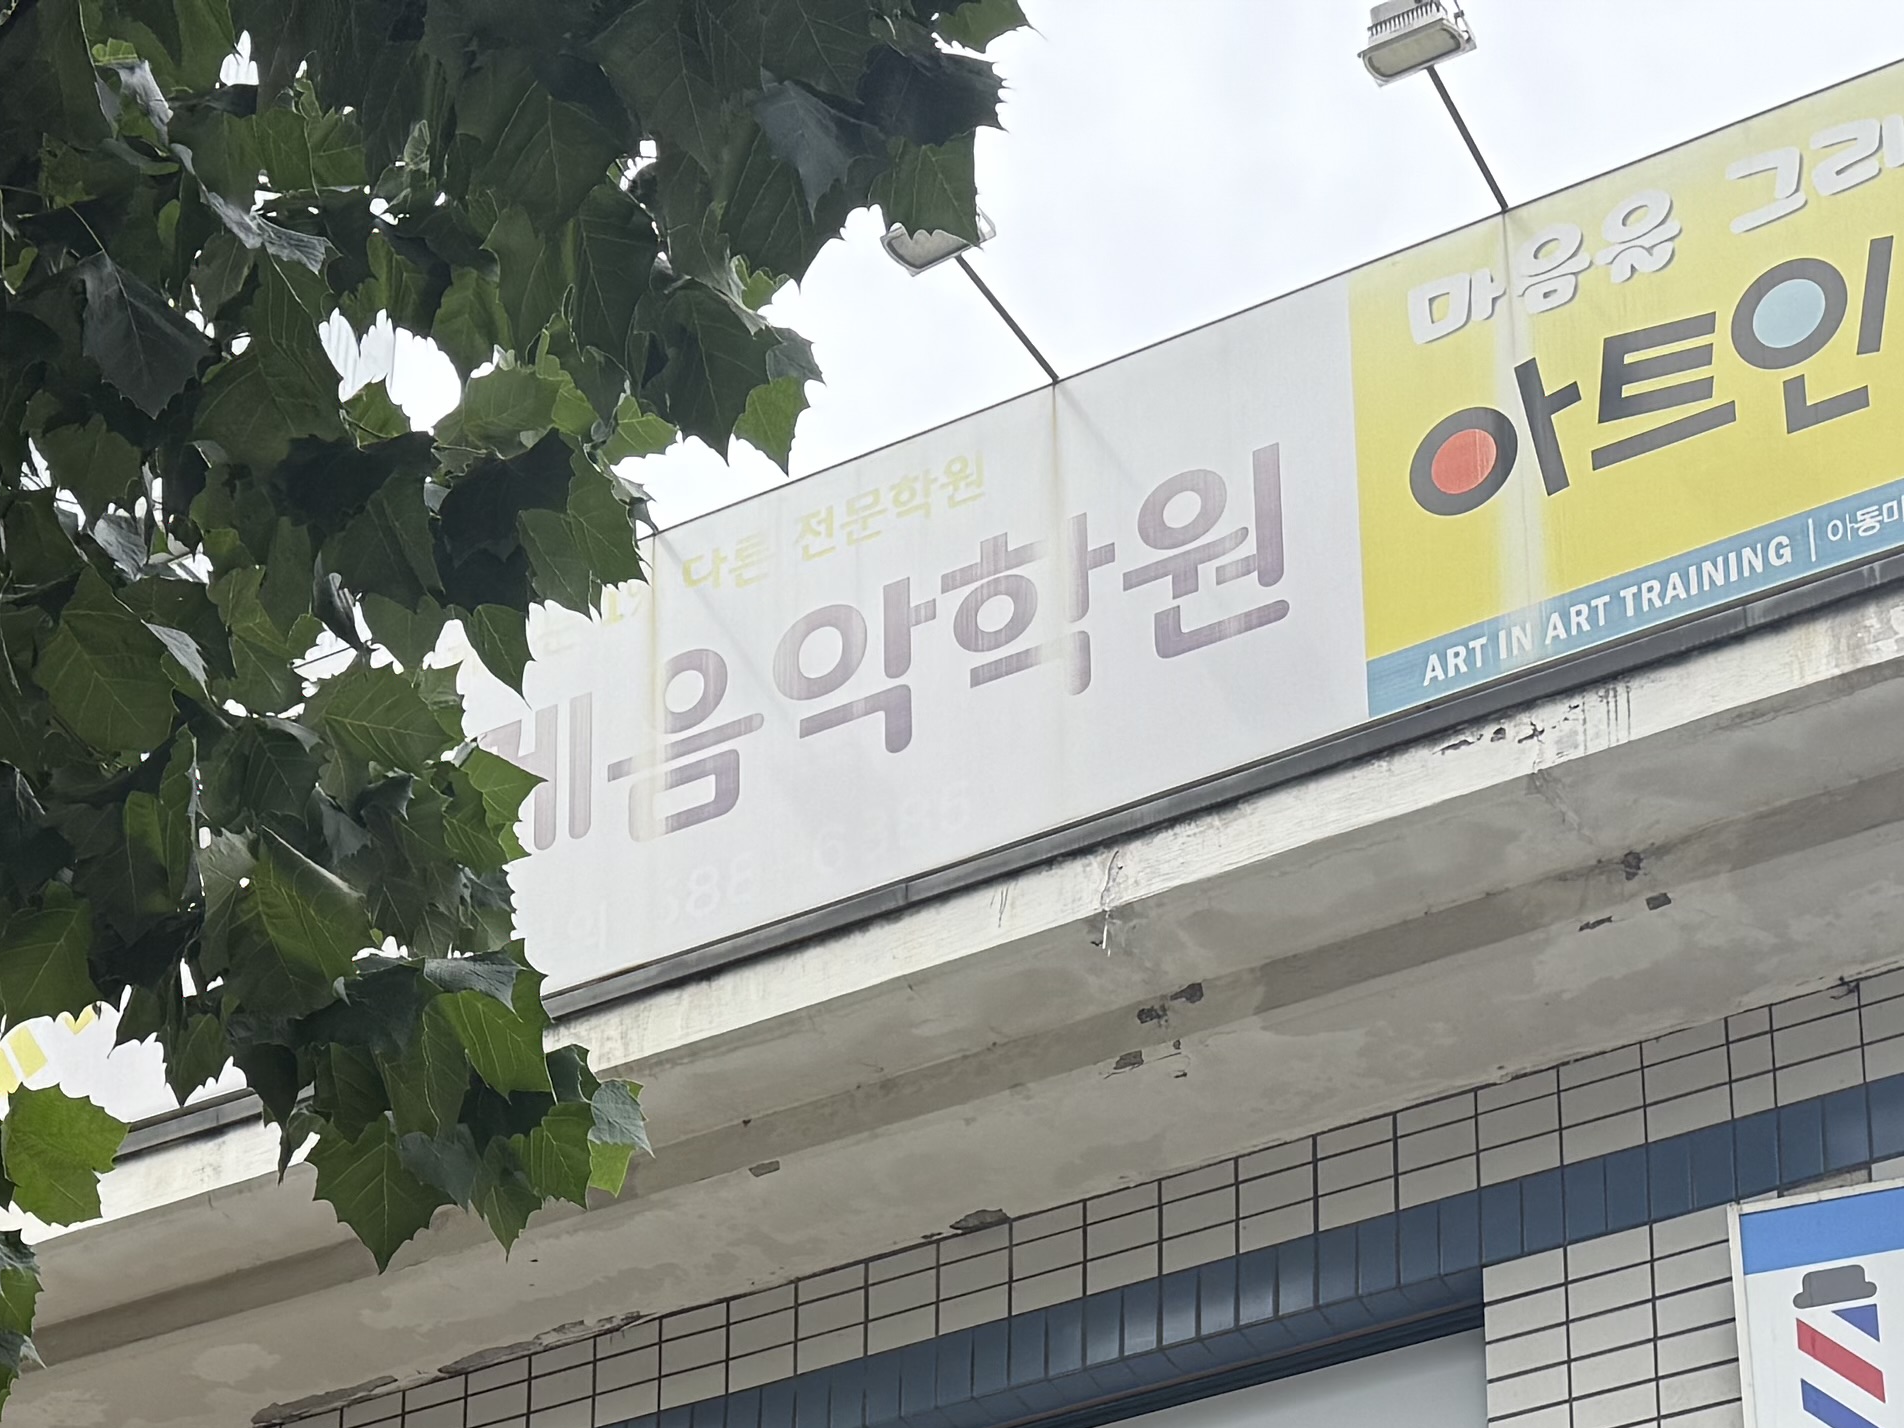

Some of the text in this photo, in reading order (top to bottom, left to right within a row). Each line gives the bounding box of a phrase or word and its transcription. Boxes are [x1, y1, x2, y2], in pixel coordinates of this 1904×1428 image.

[1407, 189, 1681, 345] 마음을
[1408, 234, 1896, 517] 아트인
[794, 450, 986, 562] 전문학원
[1421, 535, 1793, 687] ART ART TRAINING
